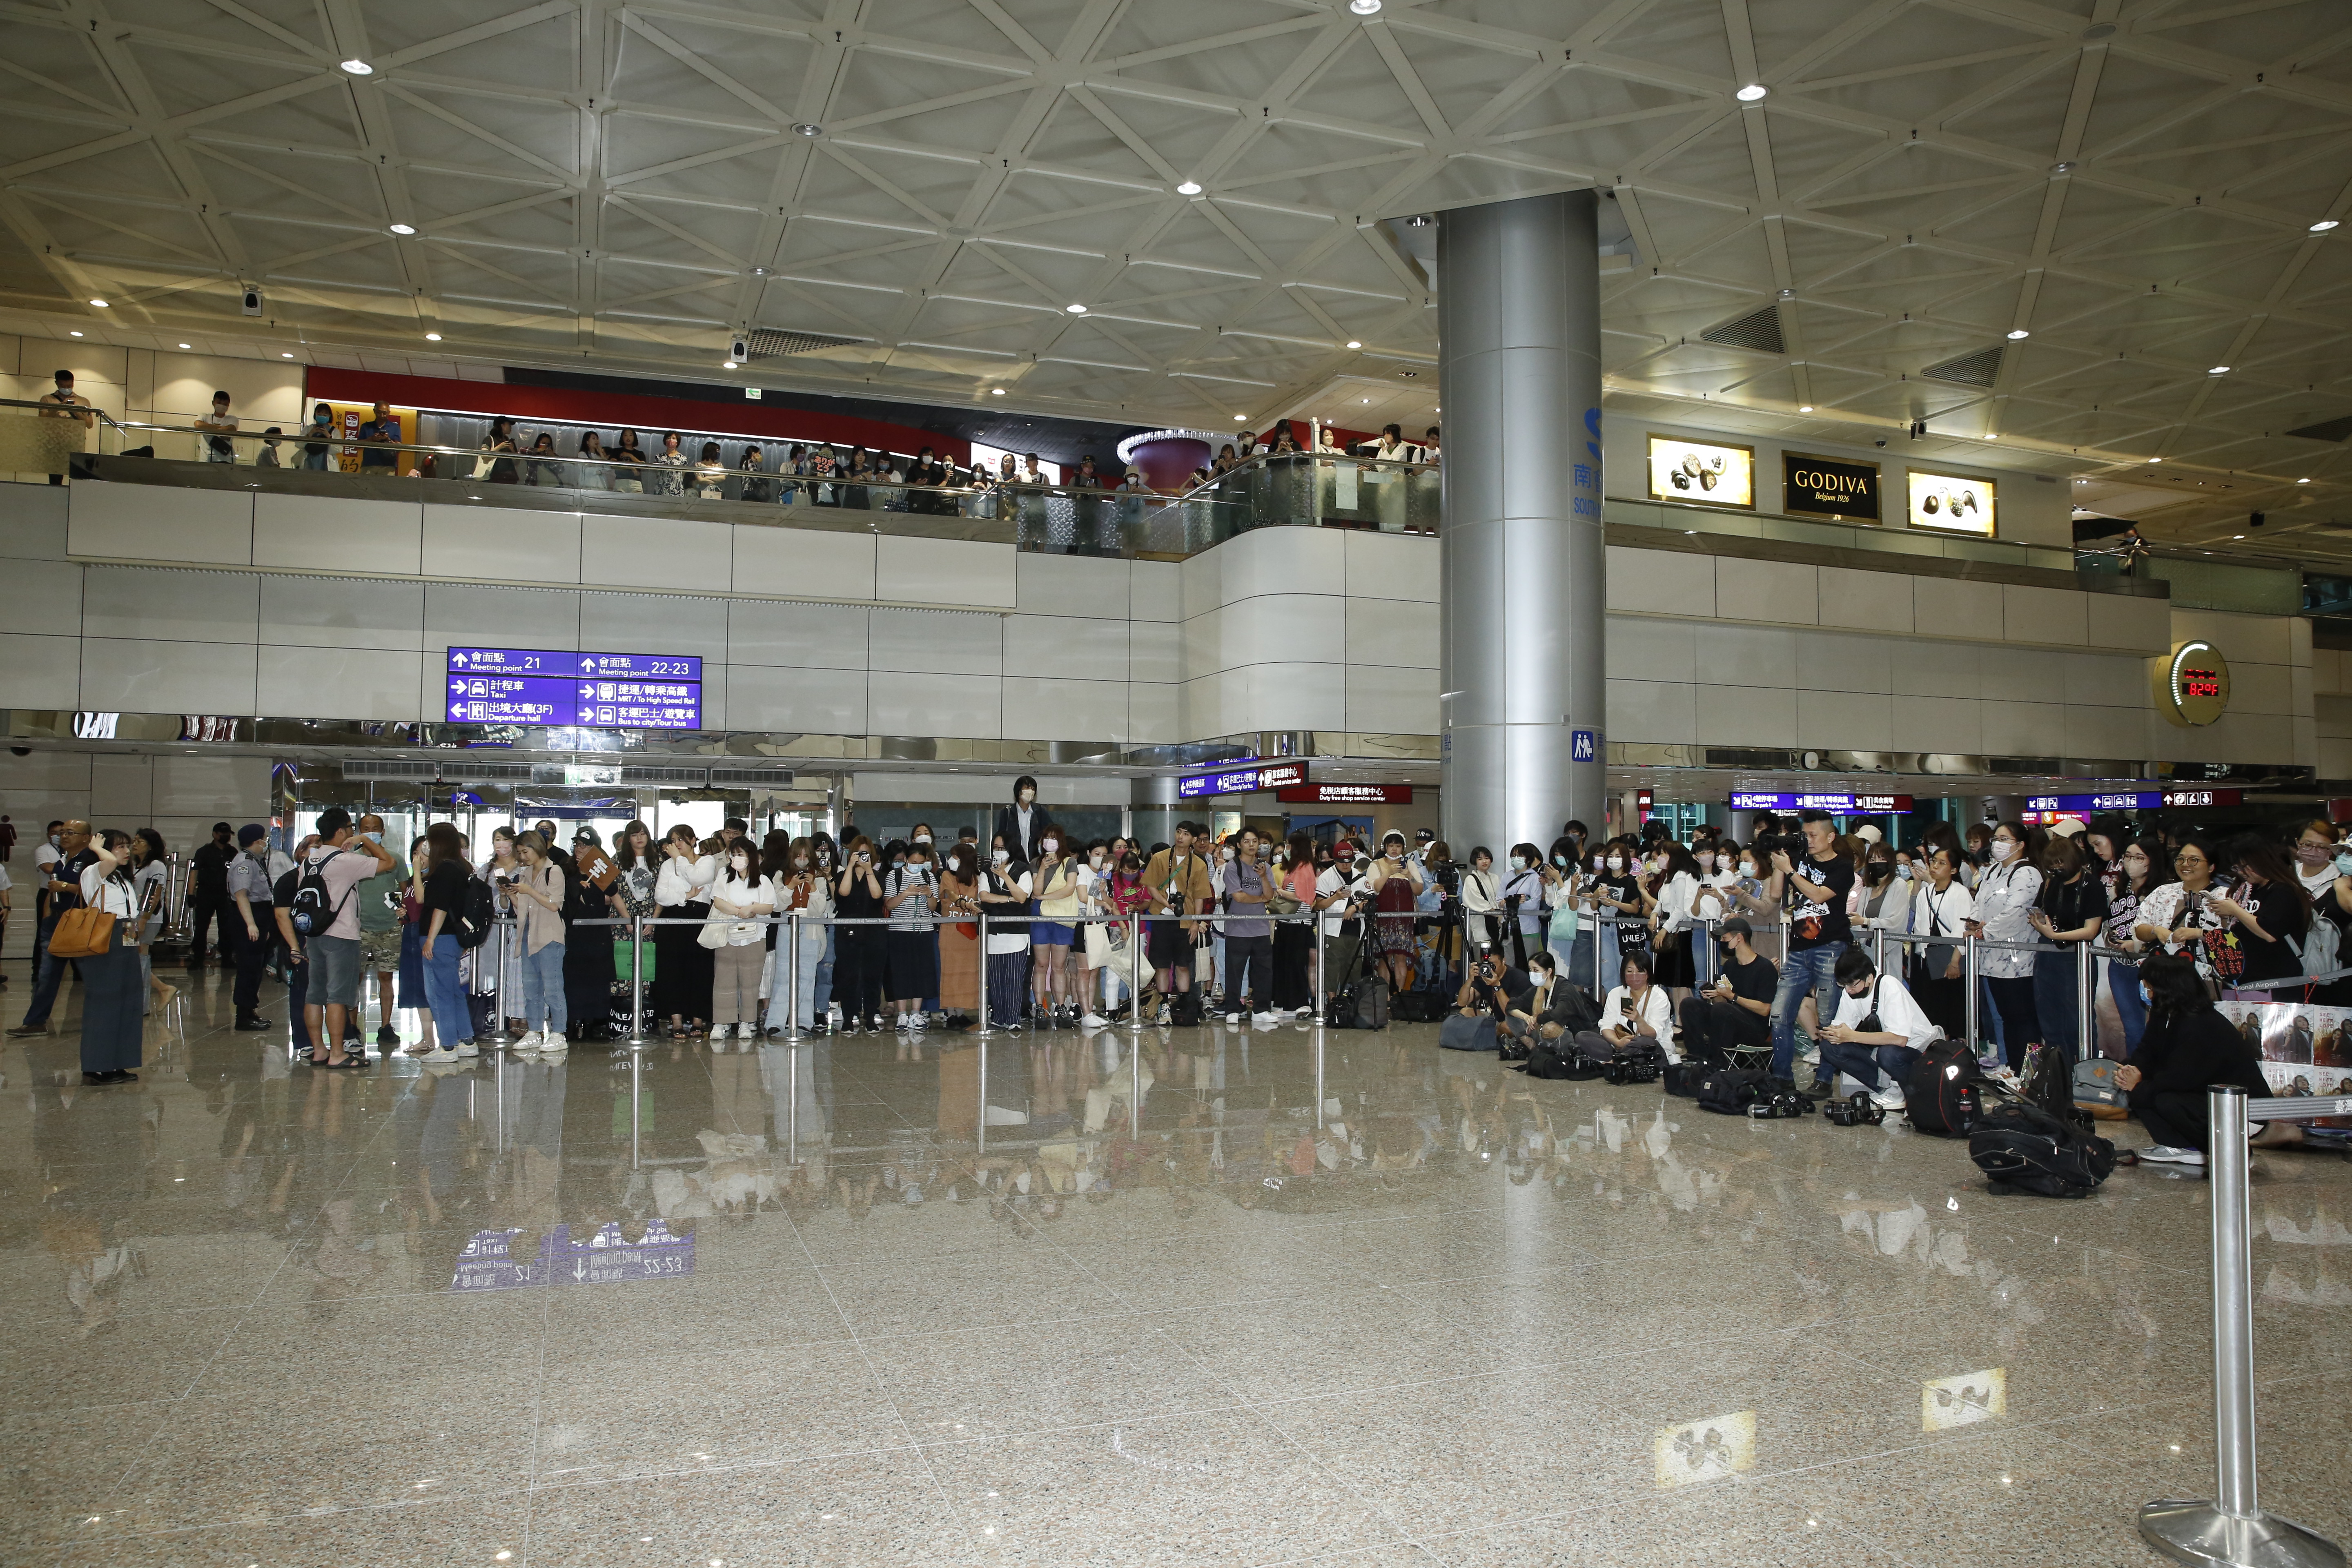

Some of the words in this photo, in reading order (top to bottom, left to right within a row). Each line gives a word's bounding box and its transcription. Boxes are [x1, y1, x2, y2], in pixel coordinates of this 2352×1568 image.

[1795, 470, 1866, 494] GODIVA
[1815, 492, 1835, 501] Belgium
[1837, 494, 1849, 503] 1926
[471, 651, 505, 663] 會面點
[524, 657, 540, 669] 21
[599, 657, 631, 668] 會面點
[470, 664, 501, 673] Meeting
[599, 668, 628, 677] Meeting
[651, 662, 689, 675] 22-23
[490, 679, 524, 691] 計程車
[618, 684, 688, 697] 捷運/轉乘高鐵
[646, 697, 661, 705] High
[489, 702, 553, 715] 出境大廳(3F)
[618, 707, 695, 719] 客運巴士/遊覽車
[489, 715, 526, 723] Departure
[641, 719, 672, 727] city/Tour
[1272, 767, 1297, 779] 旅客服務中心
[2110, 895, 2136, 915] 山Pの
